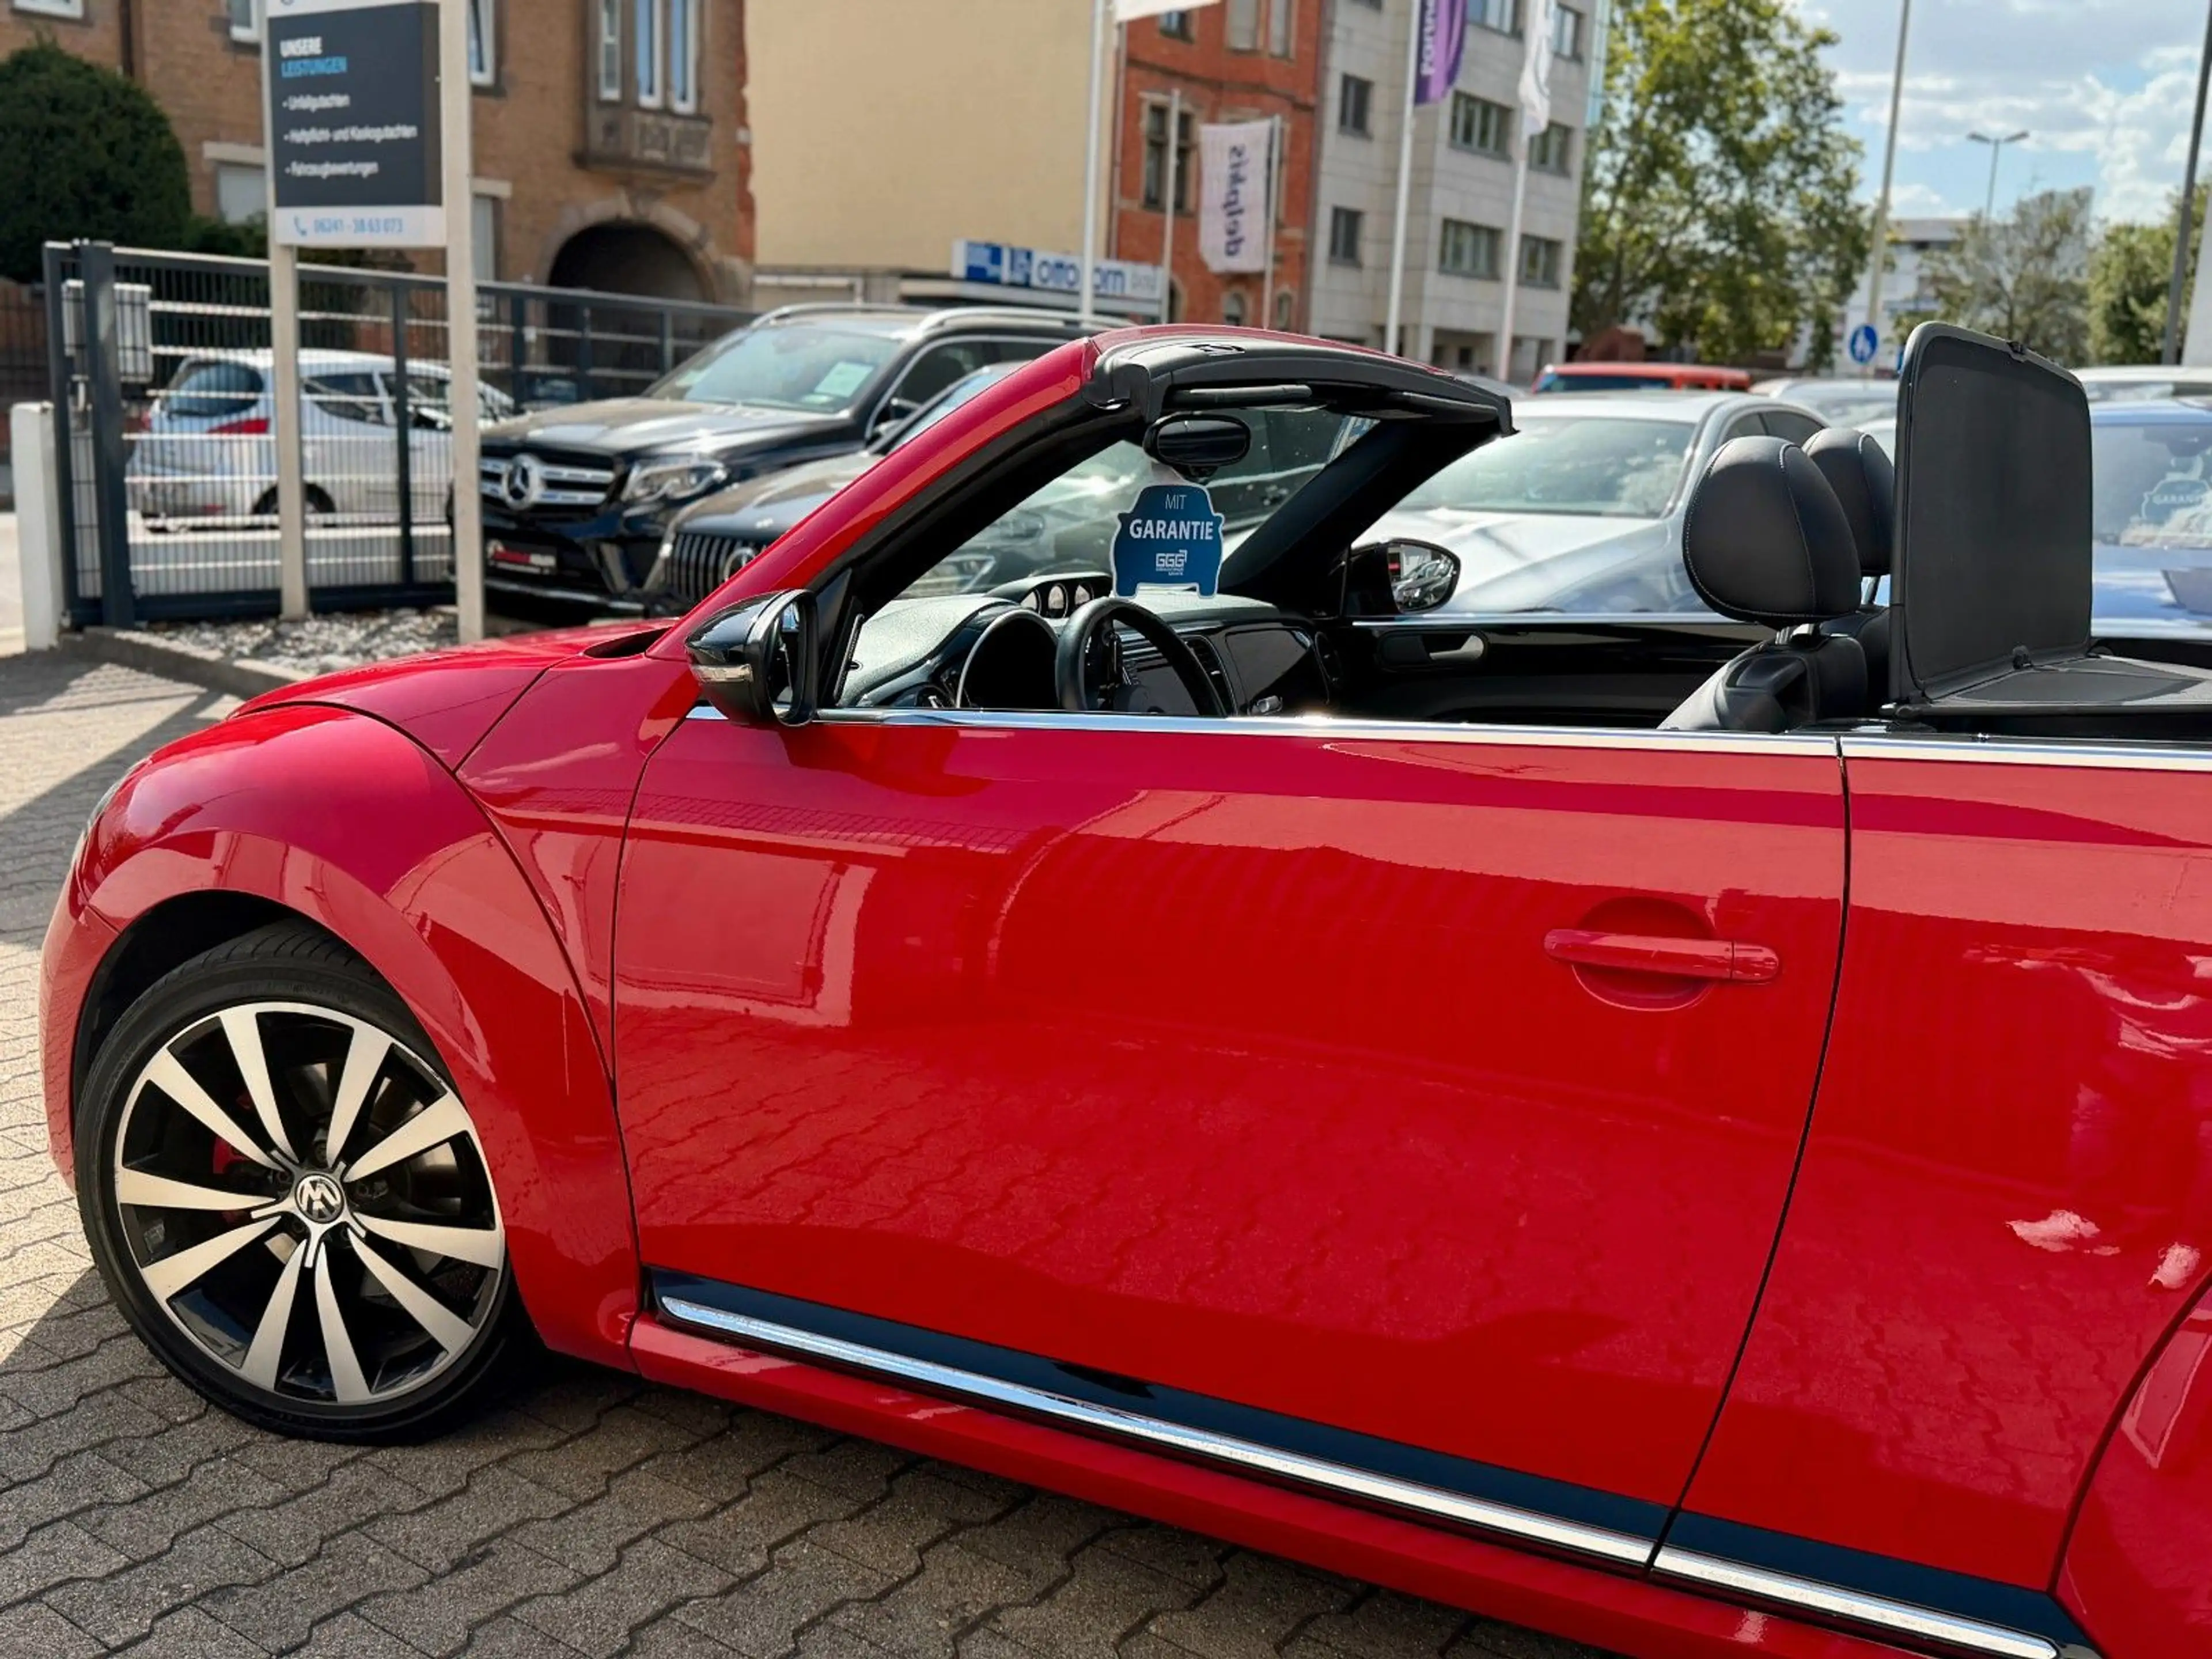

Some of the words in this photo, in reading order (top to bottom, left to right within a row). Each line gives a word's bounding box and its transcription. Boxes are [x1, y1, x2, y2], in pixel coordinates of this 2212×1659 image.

[280, 36, 322, 57] UNSERE
[281, 56, 347, 78] LEISTUNGEN
[1165, 494, 1187, 509] MIT
[1129, 519, 1214, 540] GARANTIE
[1156, 551, 1187, 568] GGG
